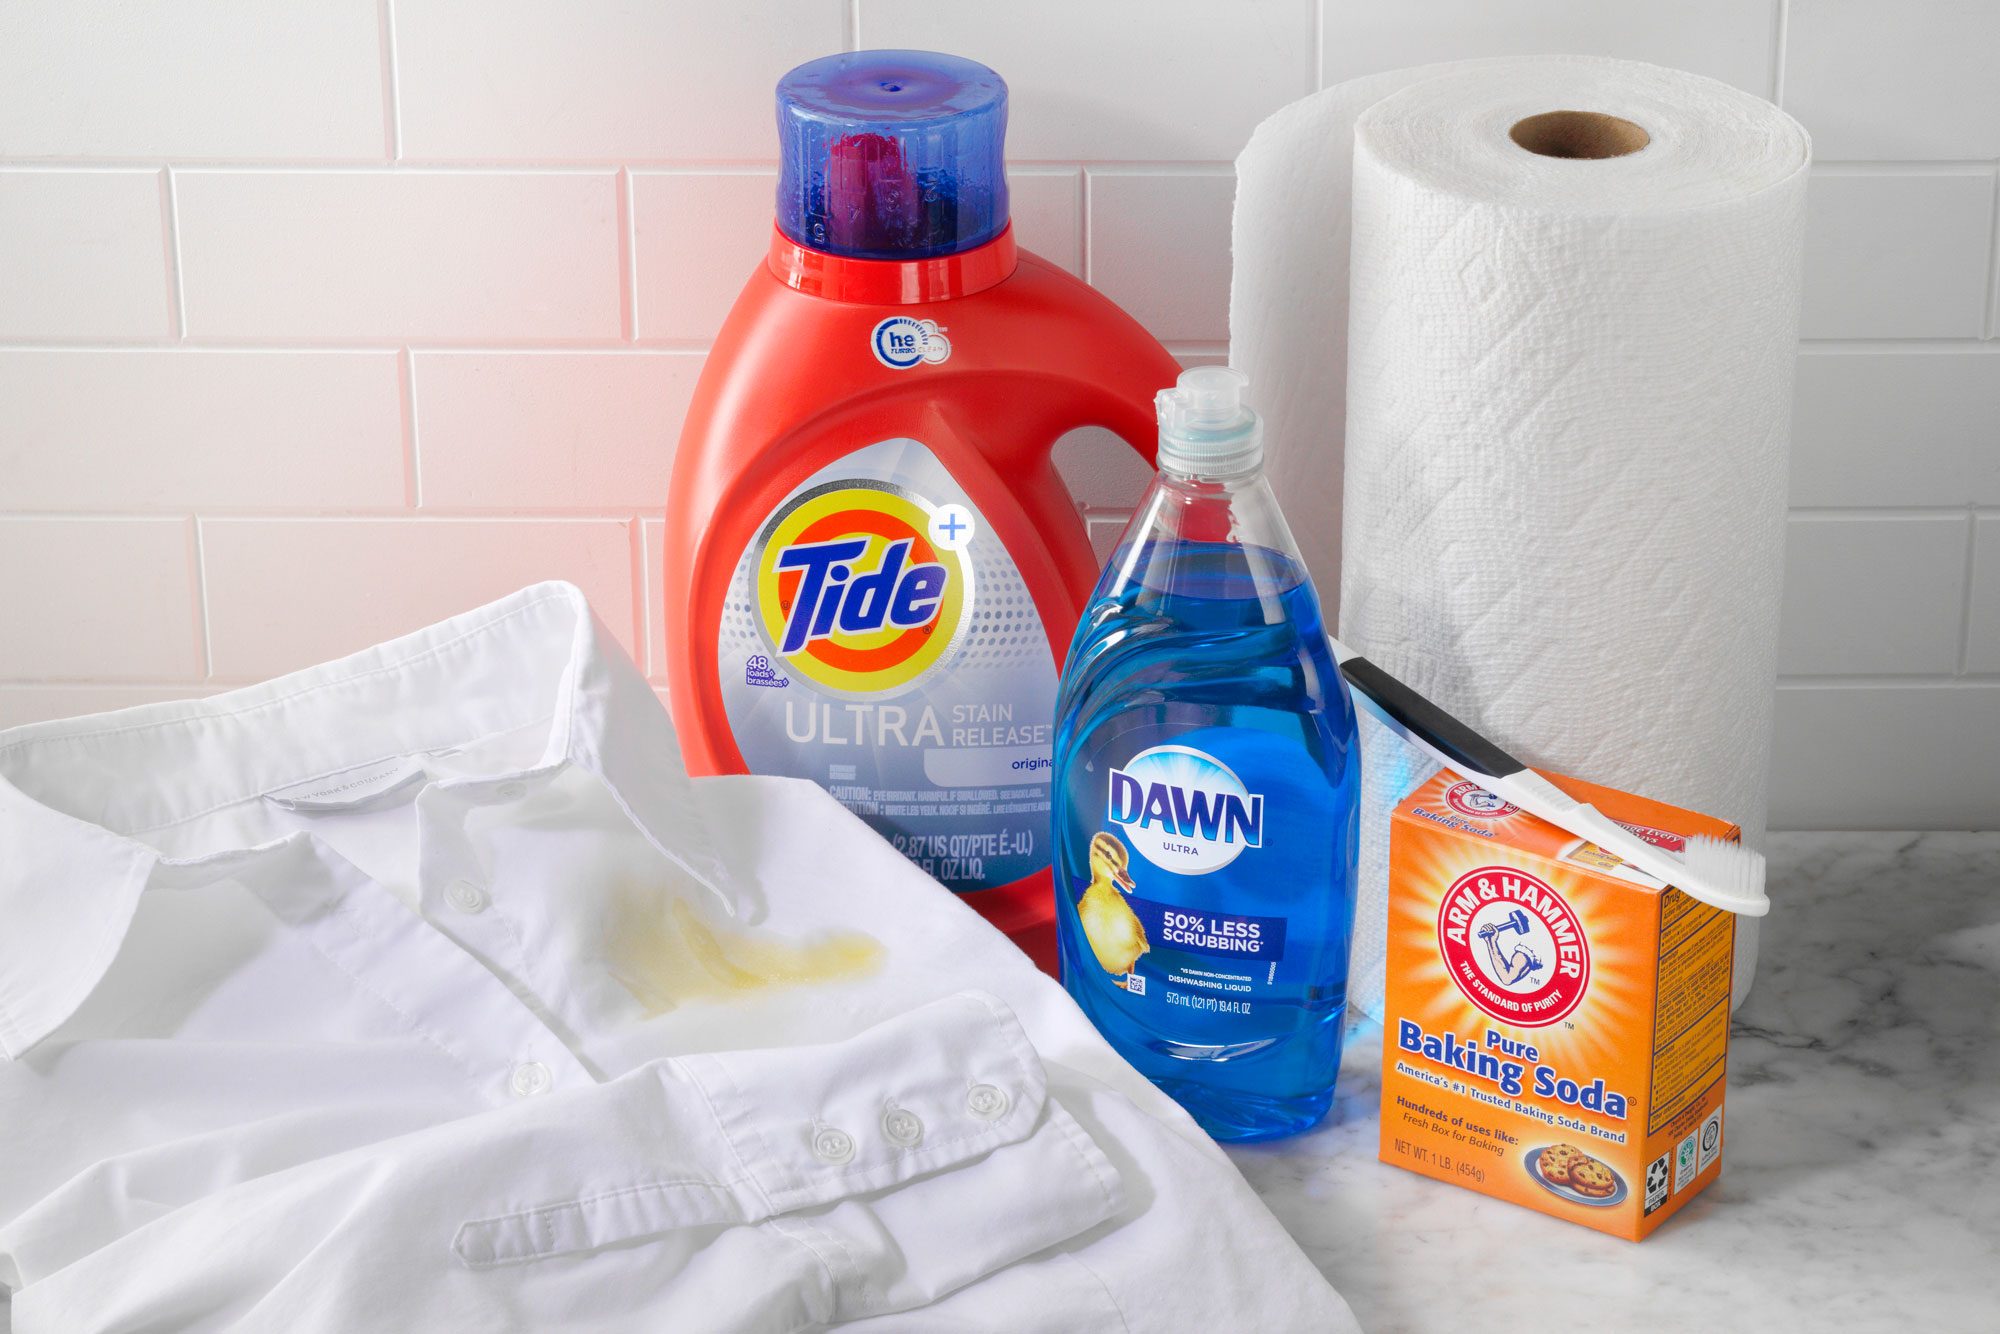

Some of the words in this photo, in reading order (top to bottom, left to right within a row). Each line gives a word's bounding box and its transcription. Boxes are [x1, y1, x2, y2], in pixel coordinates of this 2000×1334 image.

[889, 331, 915, 347] he
[775, 537, 947, 655] Tide
[746, 655, 768, 670] 48
[785, 700, 945, 747] ULTRA
[952, 703, 1012, 723] STAIN
[829, 785, 871, 801] CAUTION:
[1109, 769, 1263, 847] DAWN
[1450, 815, 1470, 824] Pure
[1412, 808, 1459, 829] Baking
[1461, 824, 1494, 838] Soda
[1647, 827, 1680, 843] Every
[928, 835, 947, 857] US
[949, 834, 998, 857] QT/PTE
[1162, 842, 1199, 856] ULTRA
[941, 858, 958, 880] OZ
[962, 858, 985, 880] LIQ.
[1663, 890, 1680, 909] Drug
[1163, 911, 1205, 933] 50%
[1210, 919, 1261, 938] LESS
[1447, 886, 1481, 947] ARM
[1477, 877, 1500, 900] &
[1501, 876, 1580, 979] HAMMER
[1168, 974, 1222, 989] DISHWASHING
[1224, 983, 1252, 992] LIQUID
[1460, 960, 1474, 981] THE
[1472, 979, 1519, 1011] STANDARD
[1521, 1002, 1533, 1012] OF
[1534, 989, 1563, 1012] PURITY
[1166, 991, 1179, 1005] 573
[1180, 995, 1191, 1007] mL
[1206, 998, 1217, 1013] PT)
[1218, 999, 1232, 1013] 19.4
[1233, 1001, 1241, 1014] FL
[1241, 1002, 1251, 1015] OZ
[1487, 1029, 1538, 1062] Pure
[1399, 1018, 1523, 1096] Baking
[1534, 1065, 1627, 1119] Soda
[1397, 1062, 1448, 1088] America's
[1453, 1082, 1465, 1094] #1
[1470, 1088, 1511, 1109] Trusted
[1515, 1103, 1554, 1125] Baking
[1557, 1116, 1586, 1132] Soda
[1590, 1125, 1625, 1143] Brand
[1396, 1095, 1448, 1122] Hundreds
[1451, 1117, 1464, 1128] of
[1466, 1122, 1491, 1137] uses
[1494, 1129, 1519, 1145] like:
[1403, 1112, 1429, 1129] Fresh
[1431, 1123, 1450, 1137] Box
[1451, 1130, 1466, 1142] for
[1468, 1136, 1505, 1157] Baking
[1394, 1138, 1412, 1155] NET
[1413, 1146, 1429, 1163] WT.
[1439, 1155, 1454, 1171] LB.
[1456, 1161, 1485, 1184] (454g)
[1648, 1190, 1665, 1205] PAPER
